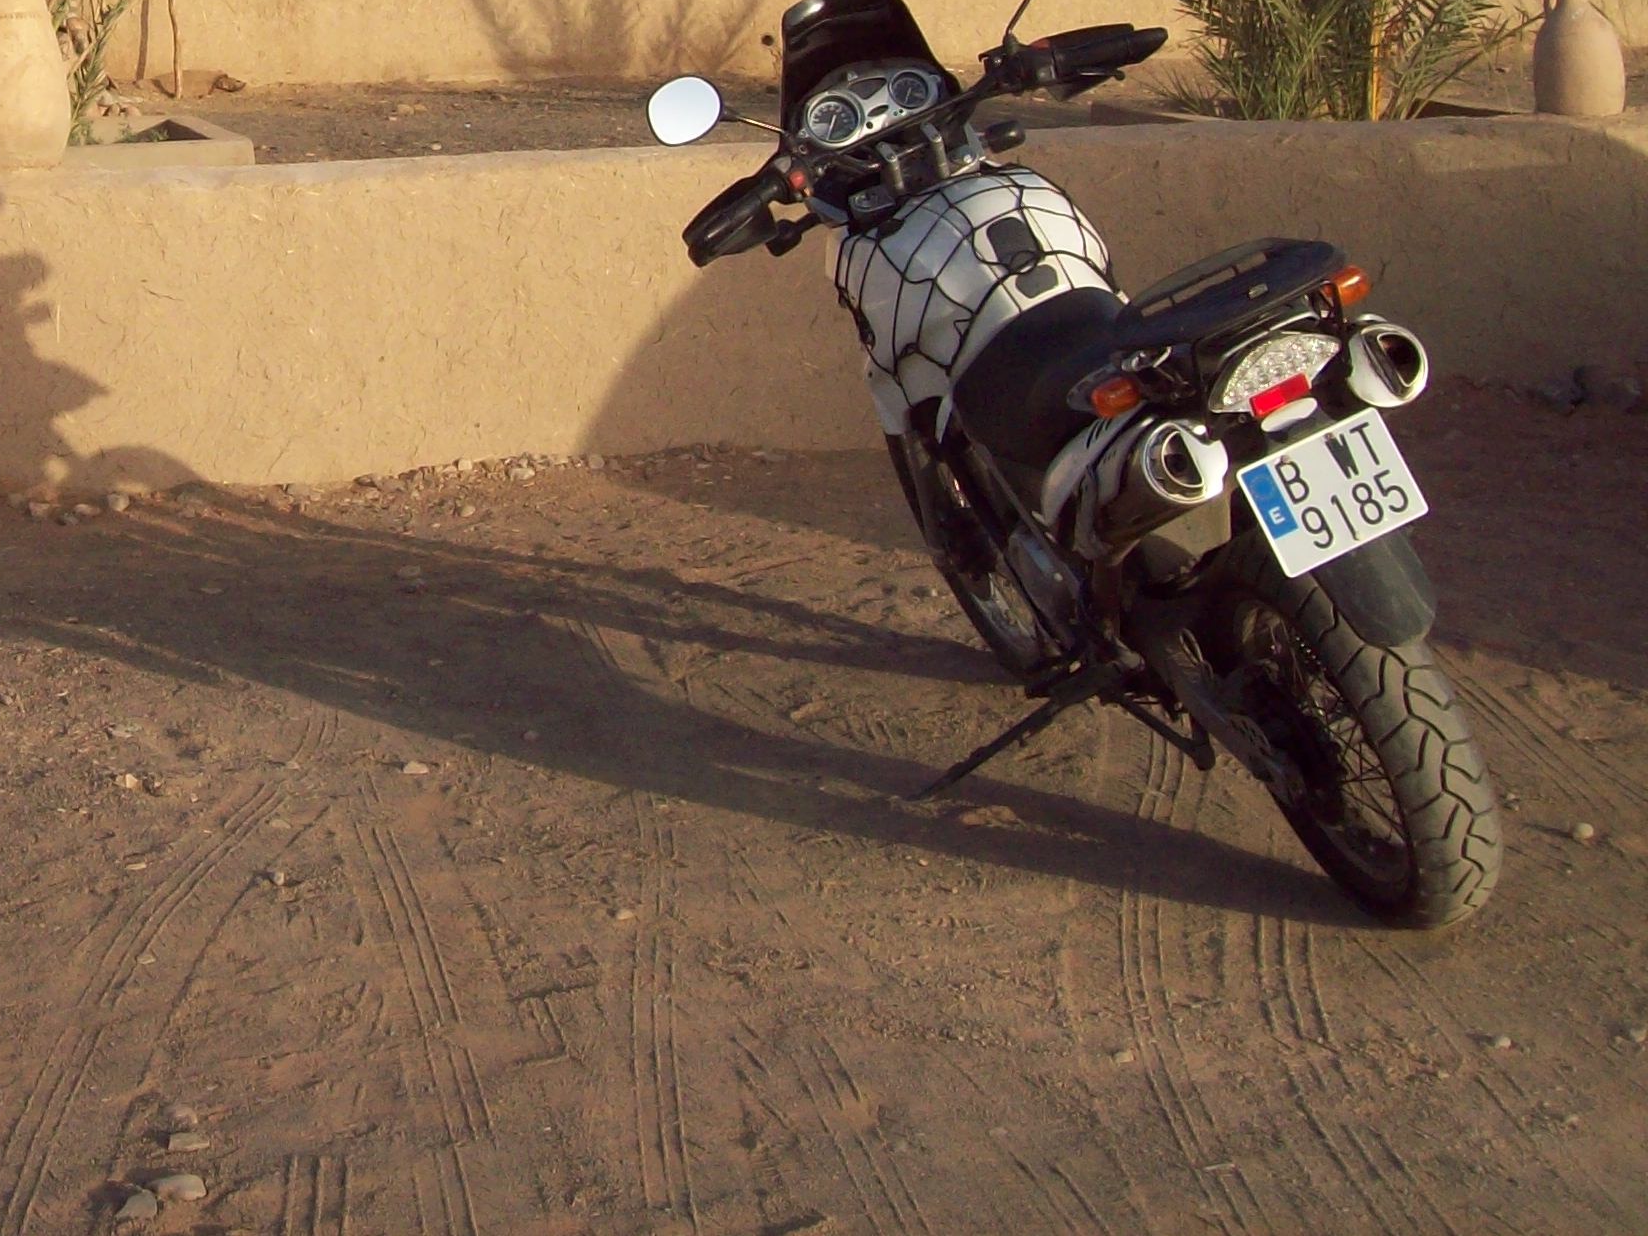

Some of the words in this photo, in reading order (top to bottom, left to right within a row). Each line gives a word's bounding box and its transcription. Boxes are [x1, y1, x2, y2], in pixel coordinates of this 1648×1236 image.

[1275, 460, 1310, 505] B
[1324, 422, 1380, 479] WT
[1268, 506, 1285, 525] E
[1301, 469, 1409, 550] 9185
